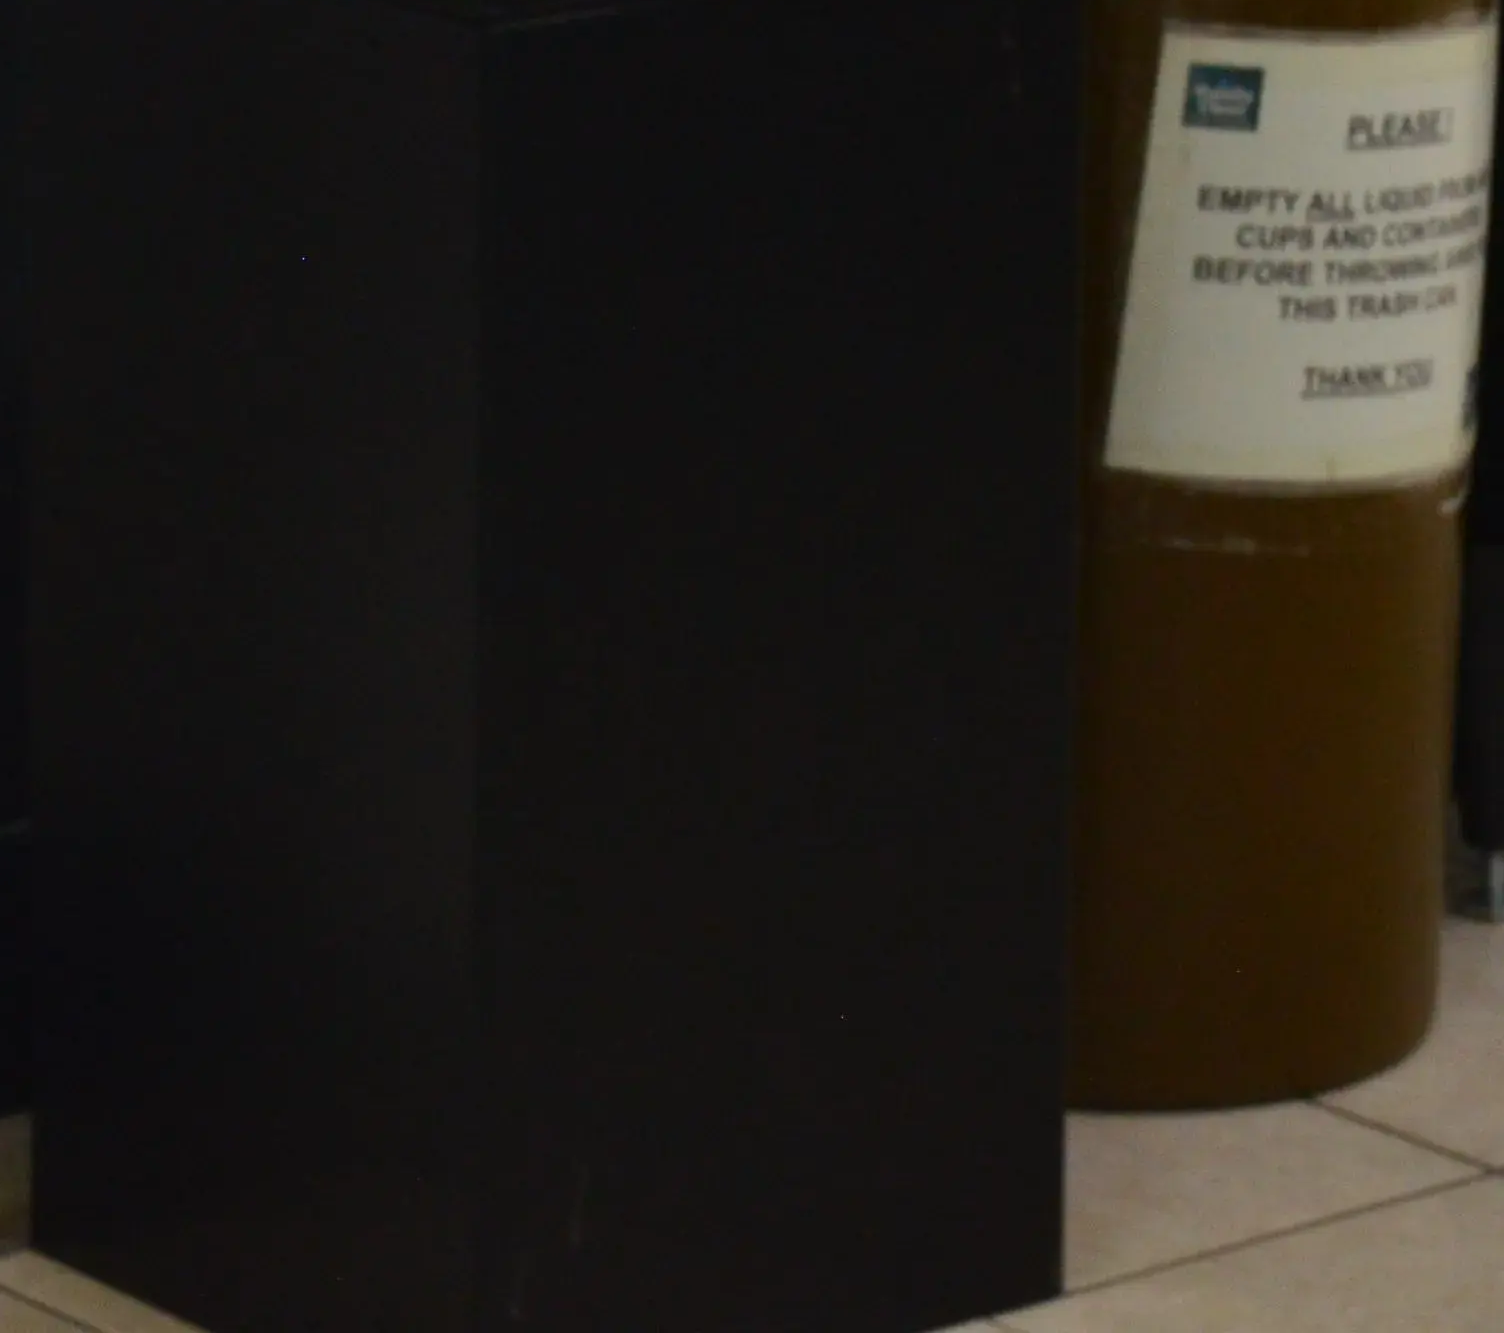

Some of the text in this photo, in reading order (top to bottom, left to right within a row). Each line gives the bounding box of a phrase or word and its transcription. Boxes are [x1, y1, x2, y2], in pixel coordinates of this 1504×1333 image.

[1197, 183, 1300, 214] EMPTY
[1306, 189, 1355, 220] ALL
[1236, 223, 1314, 251] CUPS
[1323, 223, 1378, 250] AND
[1193, 254, 1312, 287] BEFORE
[1278, 293, 1337, 322] THIS
[1303, 363, 1385, 397] THANK
